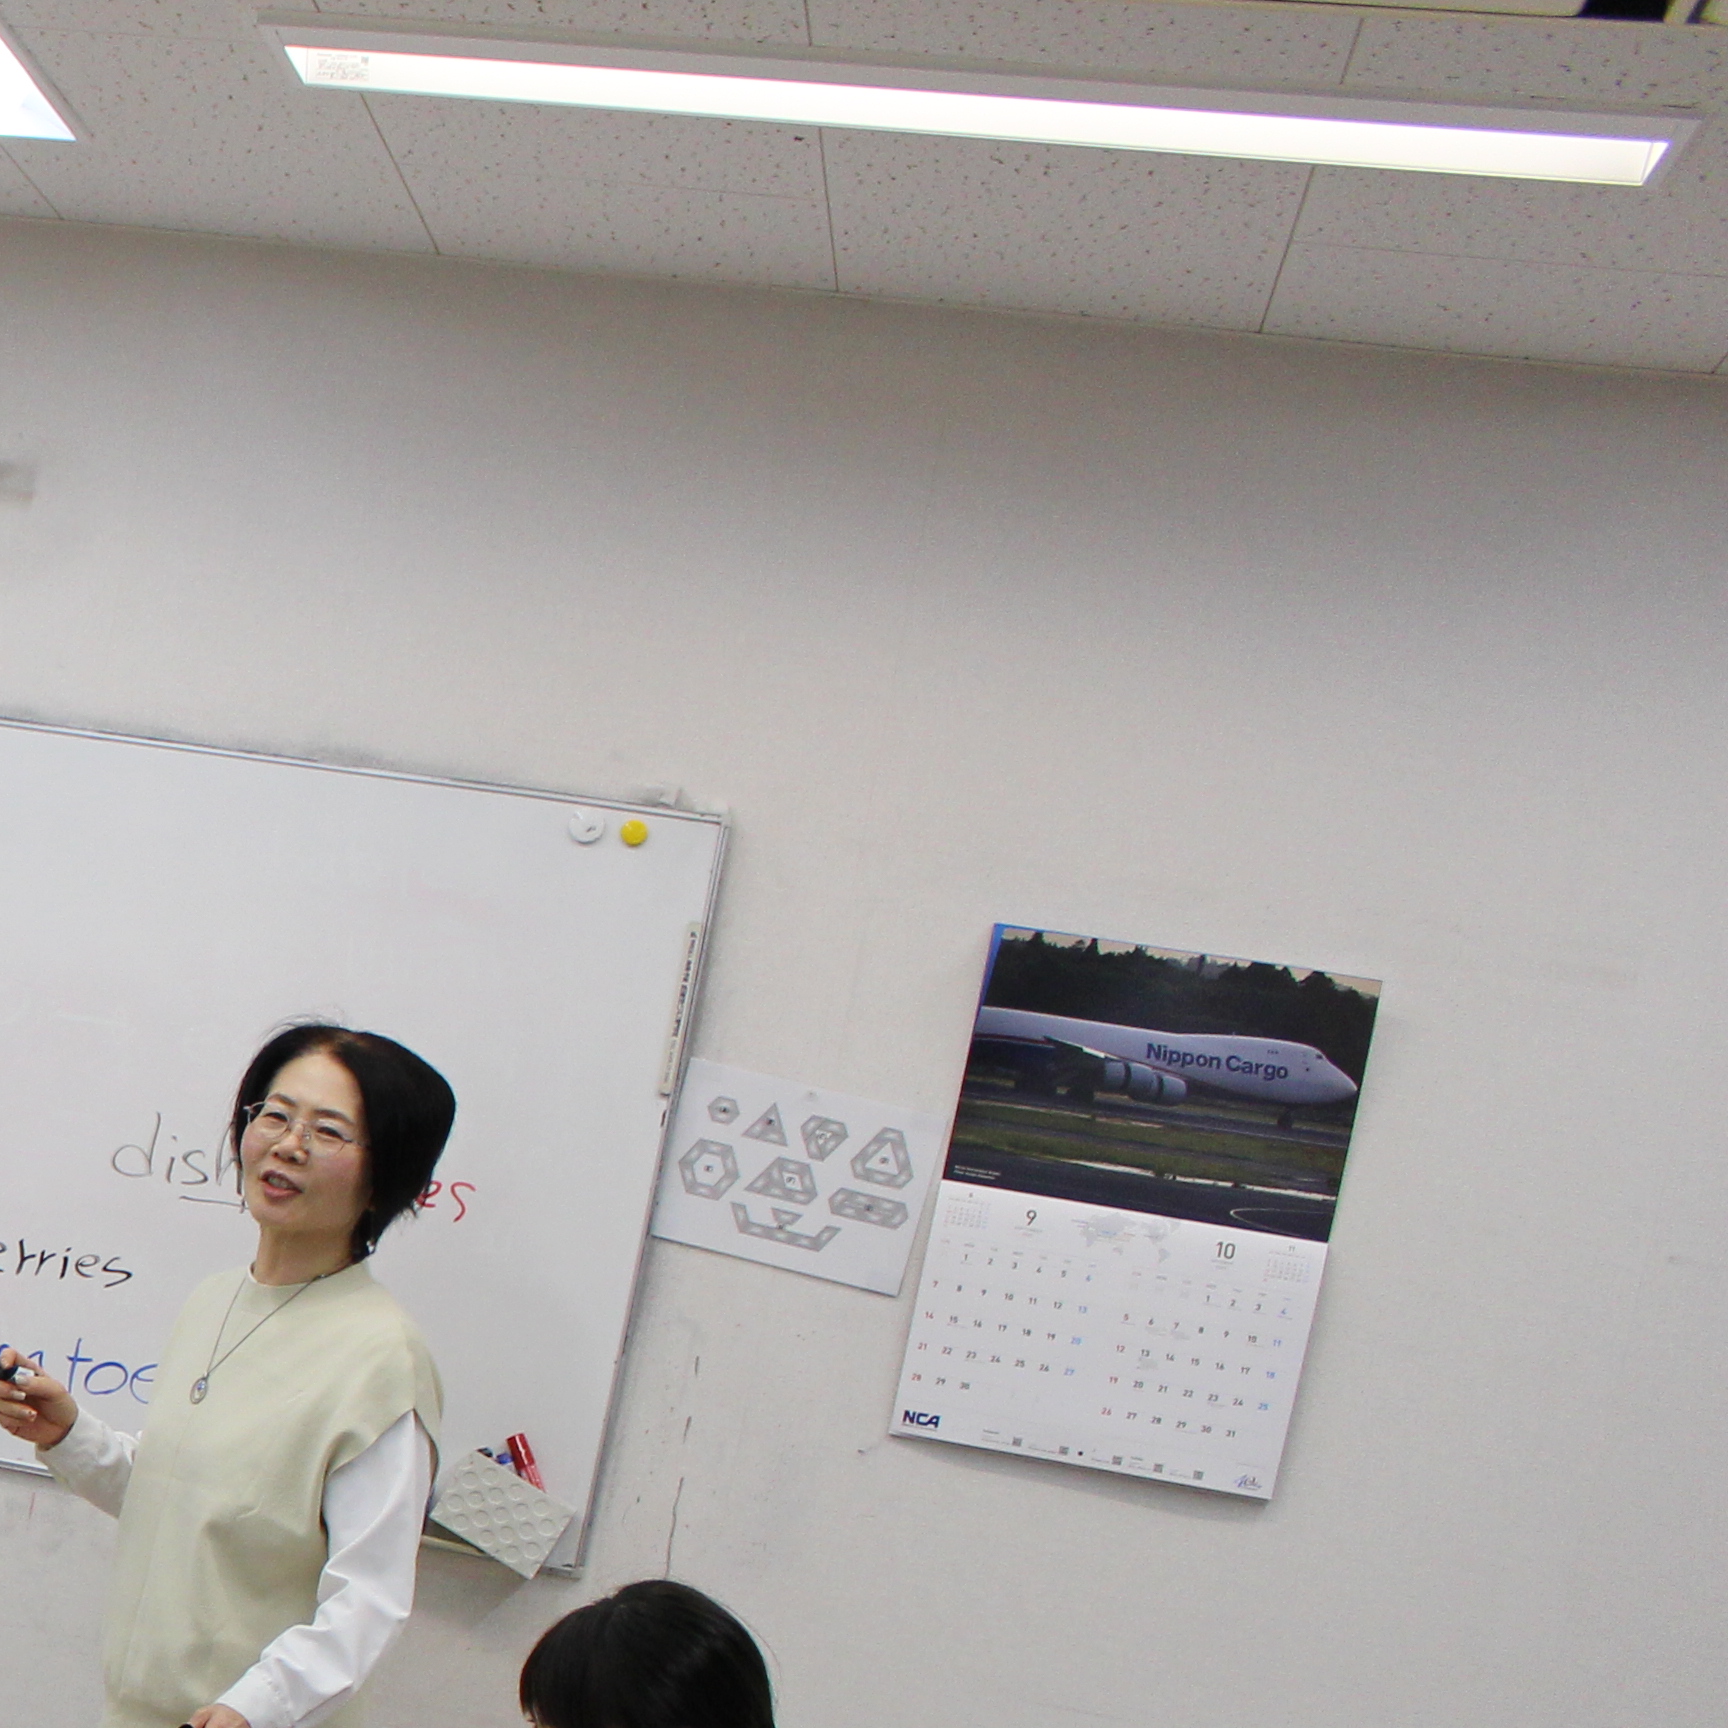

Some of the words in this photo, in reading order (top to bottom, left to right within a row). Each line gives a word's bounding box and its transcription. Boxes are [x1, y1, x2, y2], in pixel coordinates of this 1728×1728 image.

[1146, 1042, 1222, 1070] Nippon
[1226, 1055, 1289, 1081] Cargo
[1026, 1210, 1037, 1226] 9
[1215, 1241, 1236, 1260] 10
[902, 1410, 941, 1428] NCA
